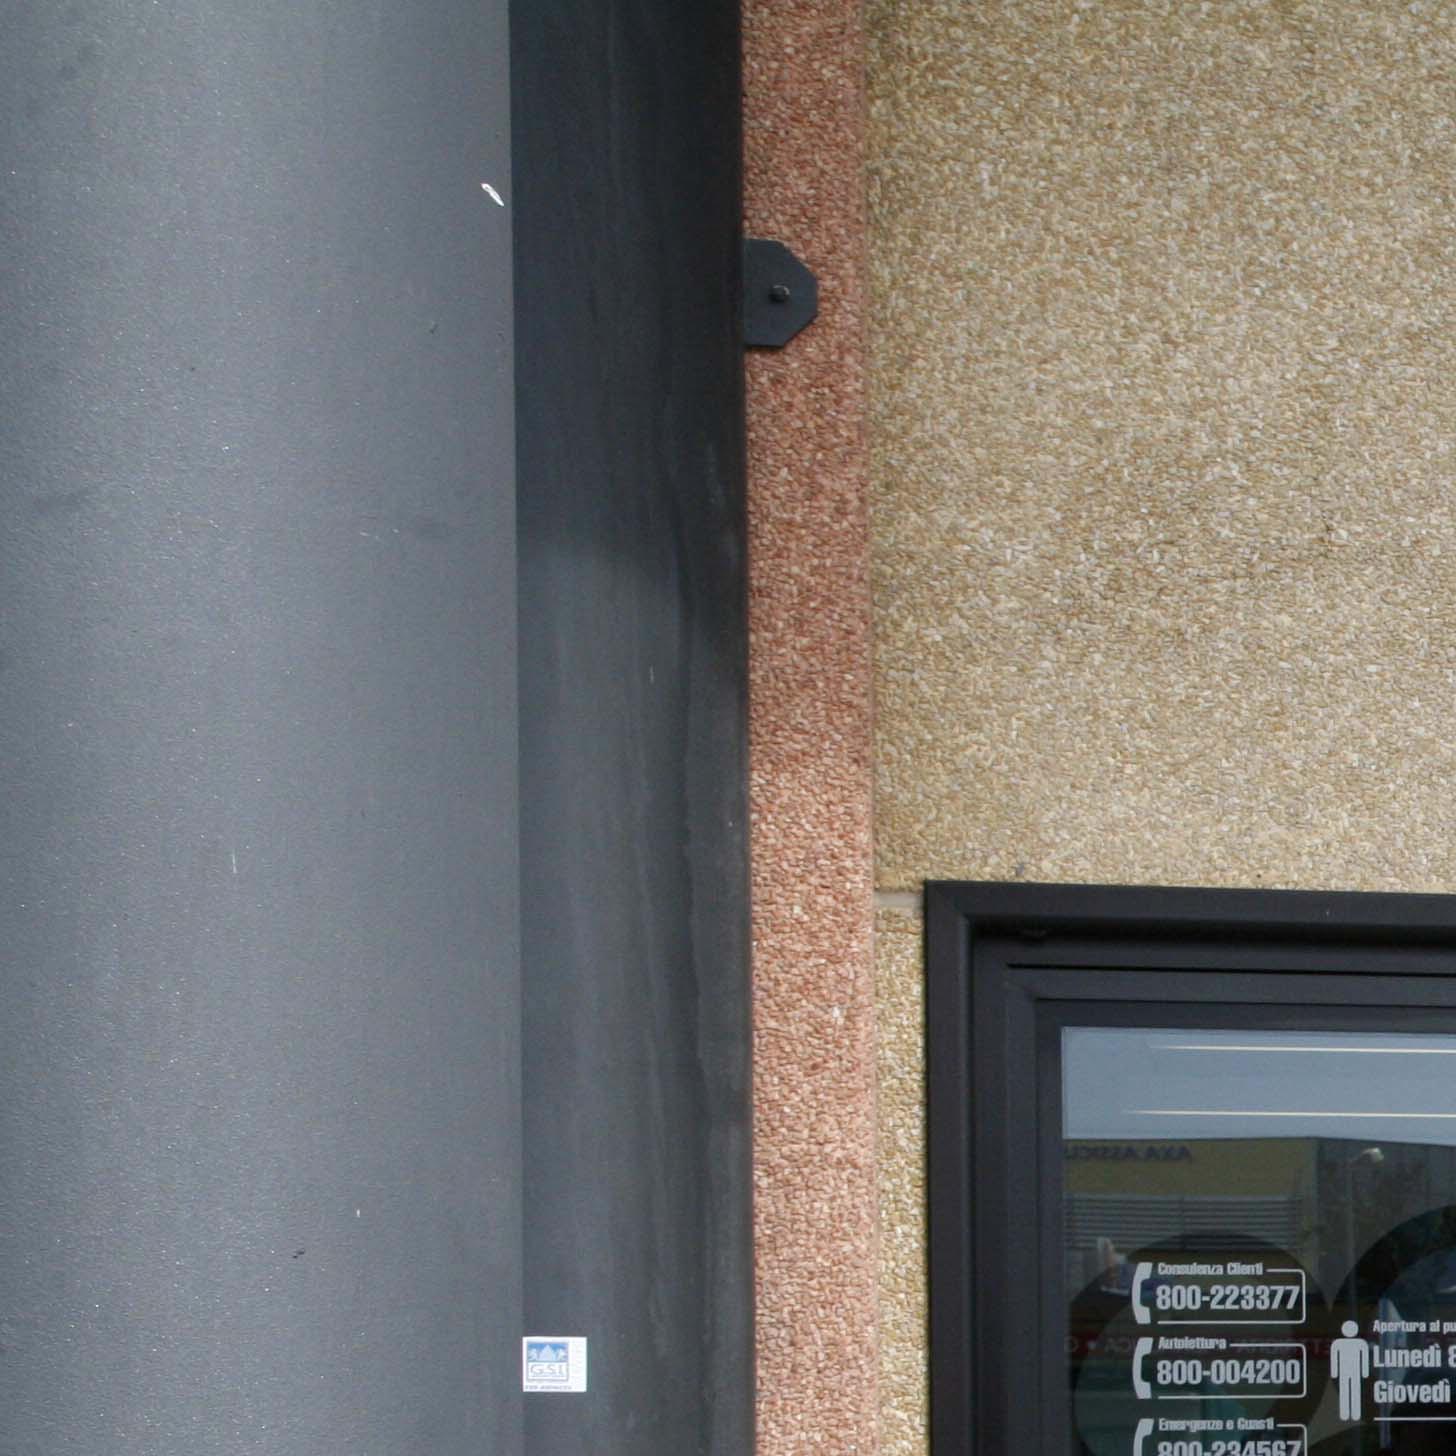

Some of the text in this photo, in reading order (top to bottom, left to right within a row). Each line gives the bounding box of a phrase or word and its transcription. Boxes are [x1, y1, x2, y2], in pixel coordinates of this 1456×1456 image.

[1157, 1262, 1264, 1276] Consulenza Clienti
[1156, 1284, 1300, 1310] 800-223377
[1373, 1319, 1427, 1333] Apertura
[1429, 1319, 1441, 1332] al
[1158, 1337, 1227, 1350] Autolettura
[1373, 1343, 1442, 1368] Lunedì
[1157, 1358, 1301, 1385] 800-004200
[1373, 1379, 1451, 1404] Giovedì
[1236, 1417, 1275, 1430] Guasti
